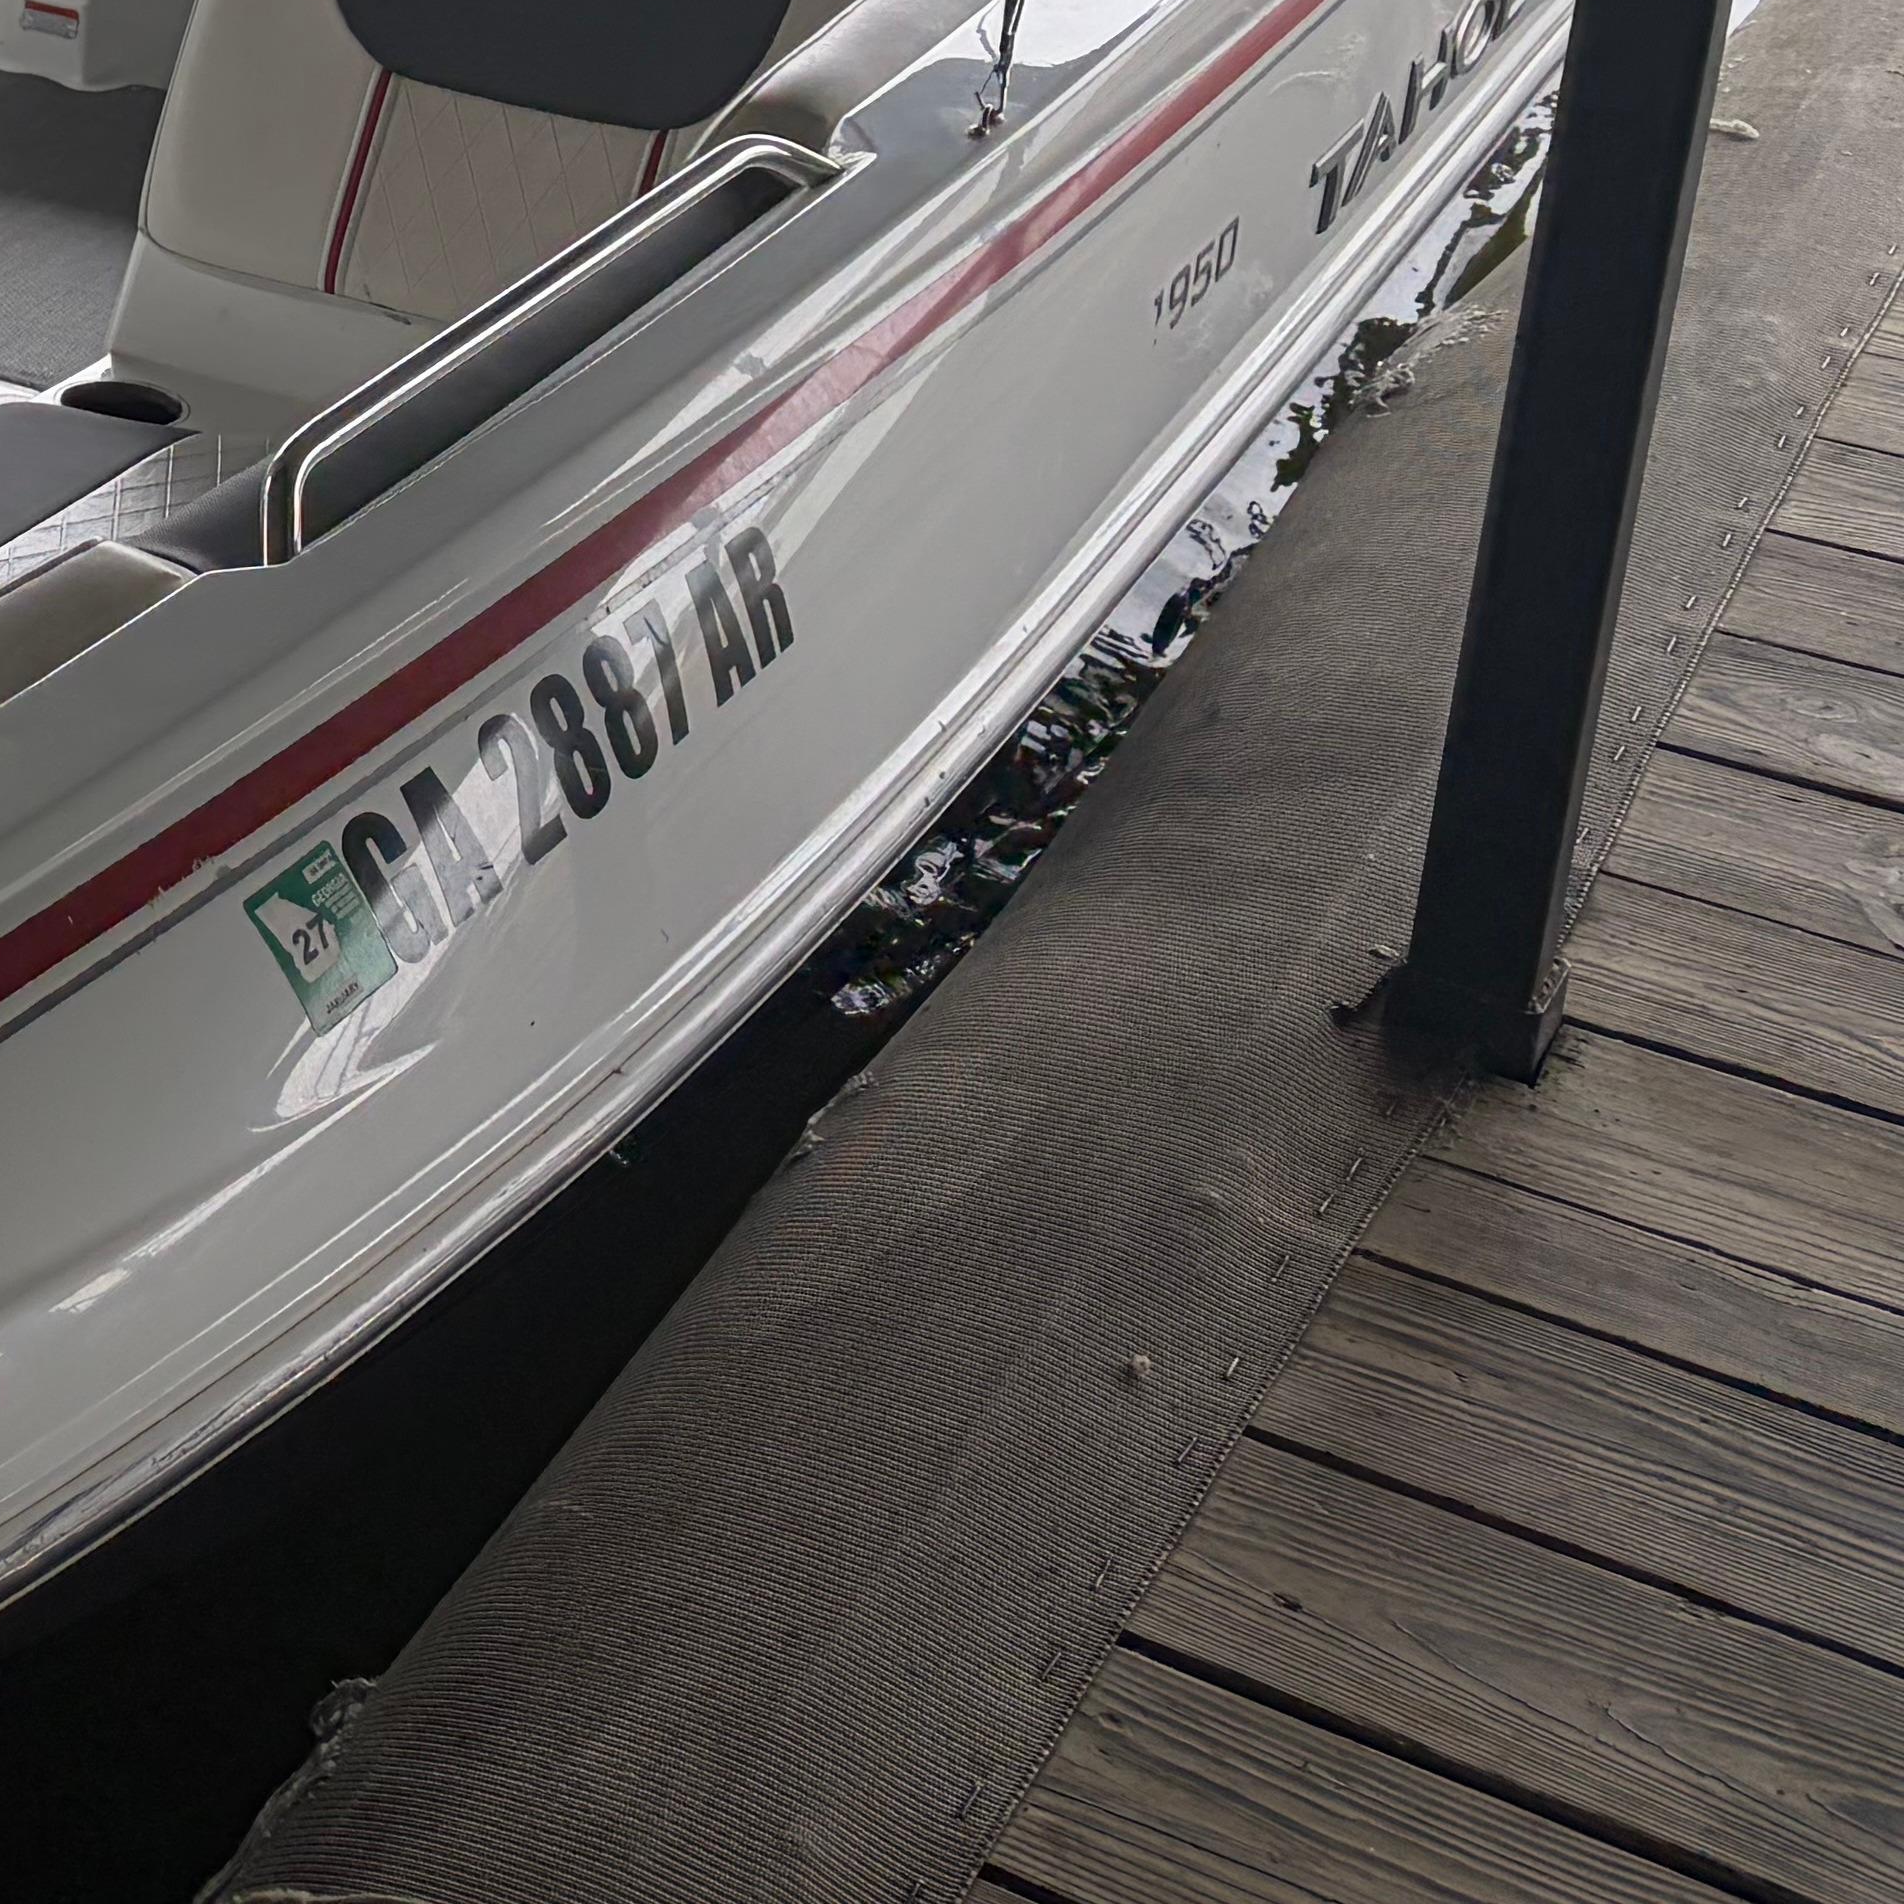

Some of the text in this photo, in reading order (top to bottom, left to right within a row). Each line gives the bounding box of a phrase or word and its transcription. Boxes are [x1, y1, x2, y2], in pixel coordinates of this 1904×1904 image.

[341, 526, 794, 963] GA 2887 AR
[293, 912, 330, 965] 27
